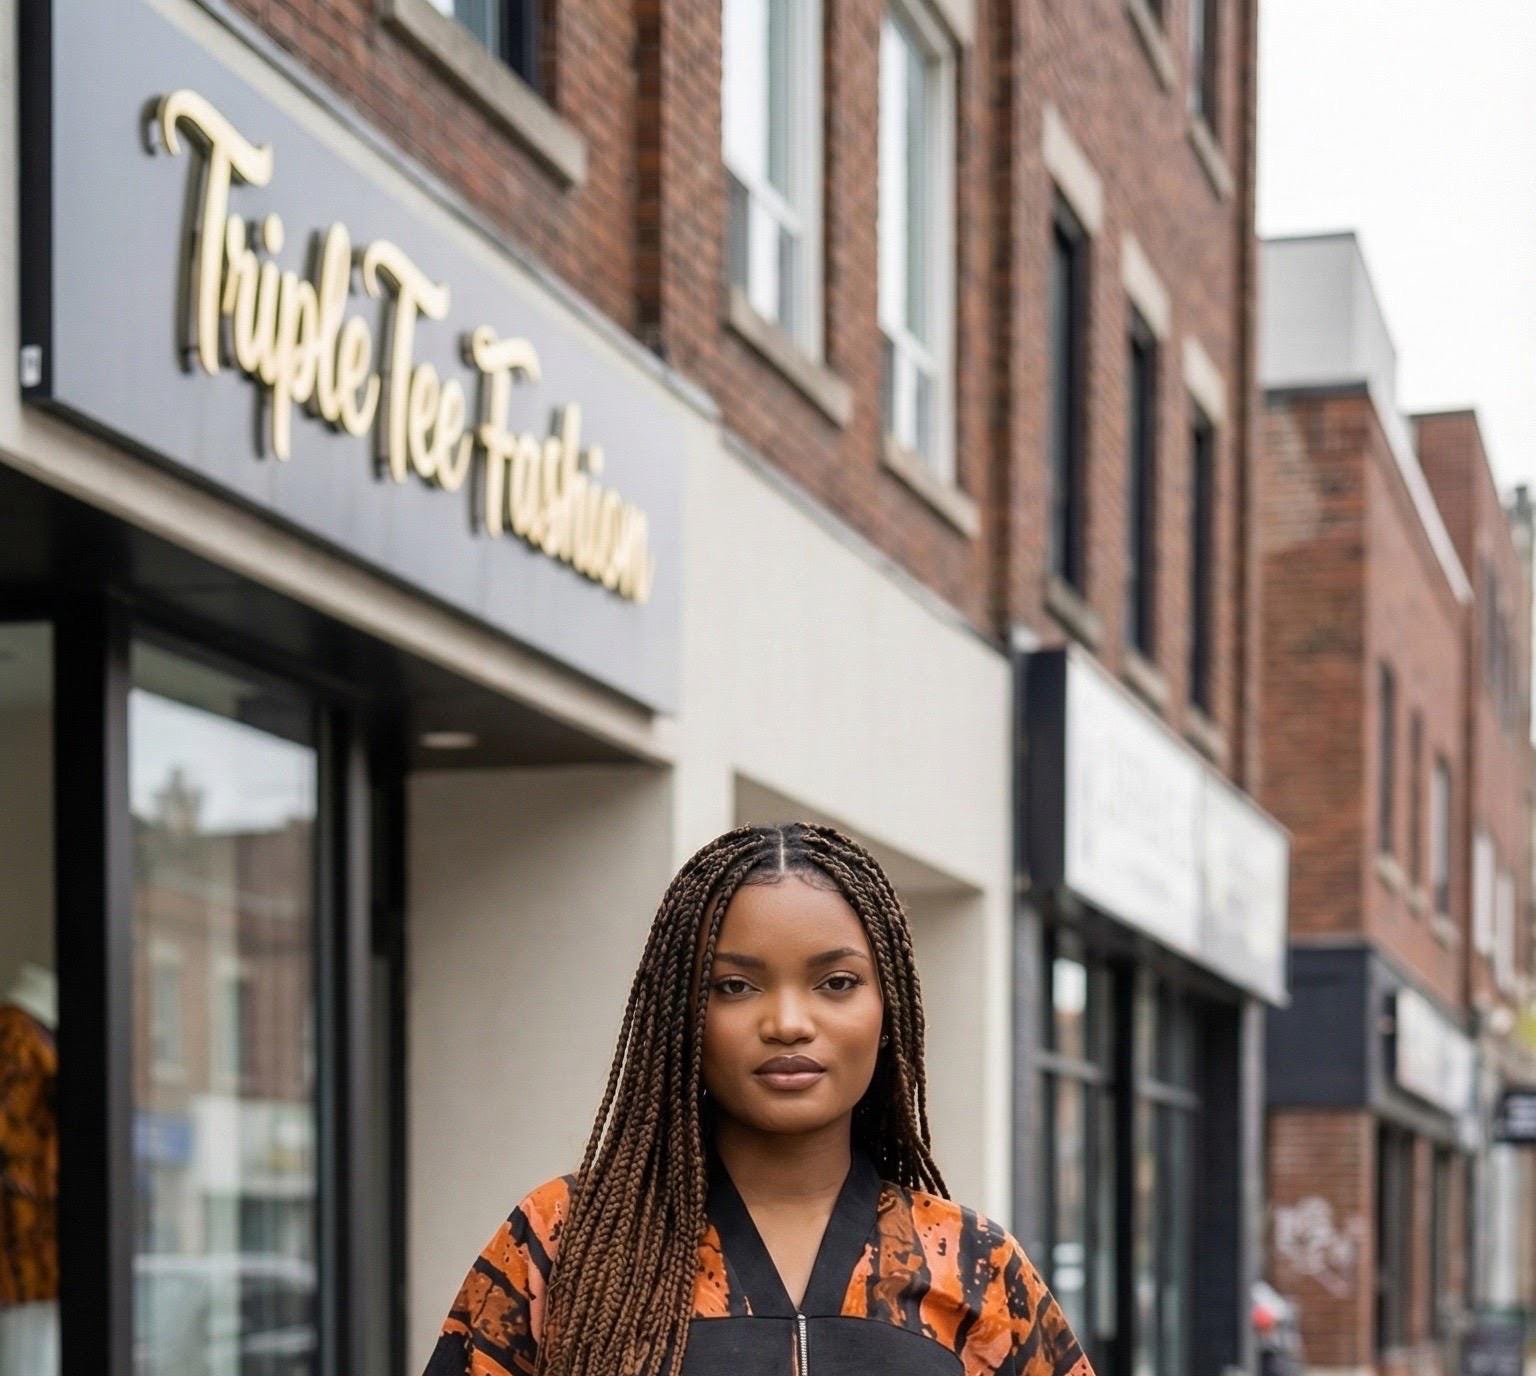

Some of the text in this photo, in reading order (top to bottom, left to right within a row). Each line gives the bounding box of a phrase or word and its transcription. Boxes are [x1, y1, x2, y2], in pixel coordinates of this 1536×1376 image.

[159, 89, 655, 604] Triple Tee Fashion
